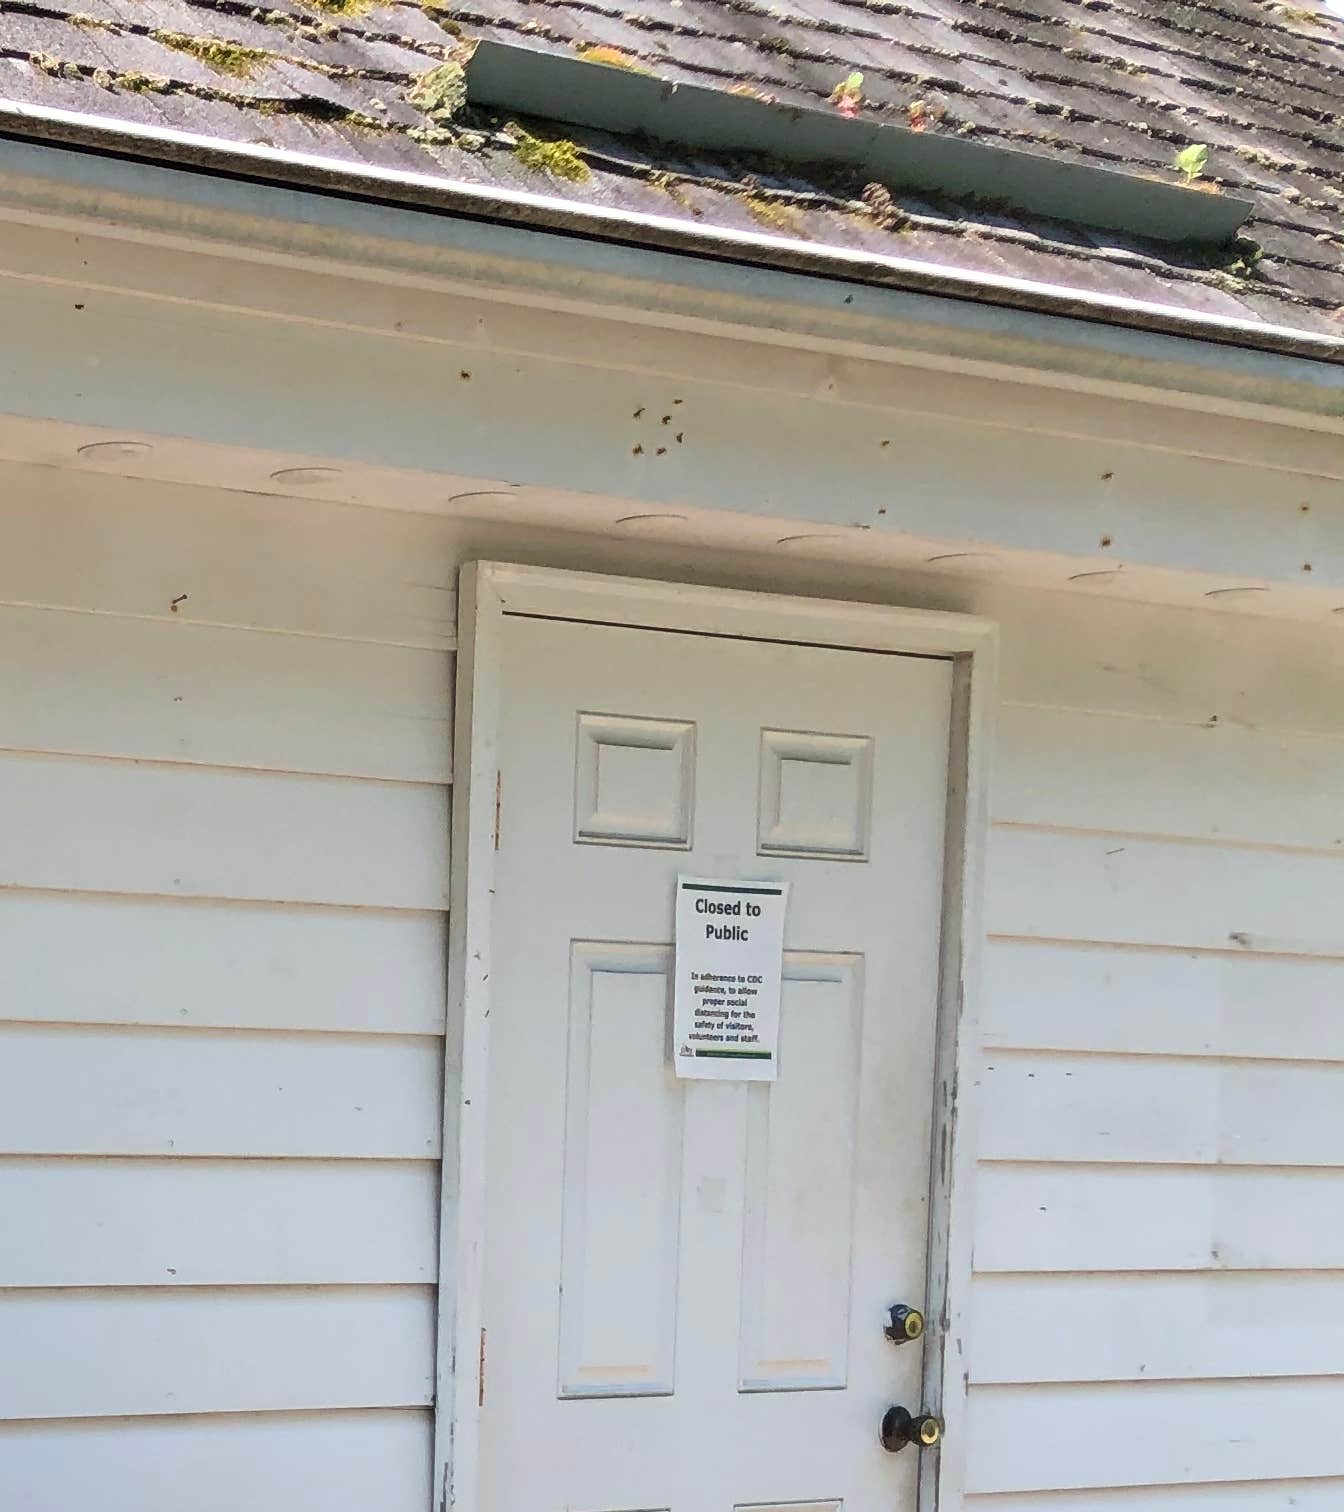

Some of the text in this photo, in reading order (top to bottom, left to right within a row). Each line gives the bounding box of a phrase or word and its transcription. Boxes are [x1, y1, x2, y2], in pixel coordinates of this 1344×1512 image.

[695, 898, 761, 917] Closed to
[706, 924, 748, 941] Public
[691, 972, 763, 984] In adherence to CDC
[738, 987, 758, 995] allow
[702, 998, 748, 1007] proper social
[694, 1008, 756, 1020] distancing for the
[694, 1020, 754, 1031] safety of visitors,
[688, 1032, 760, 1043] volunteers and staff.
